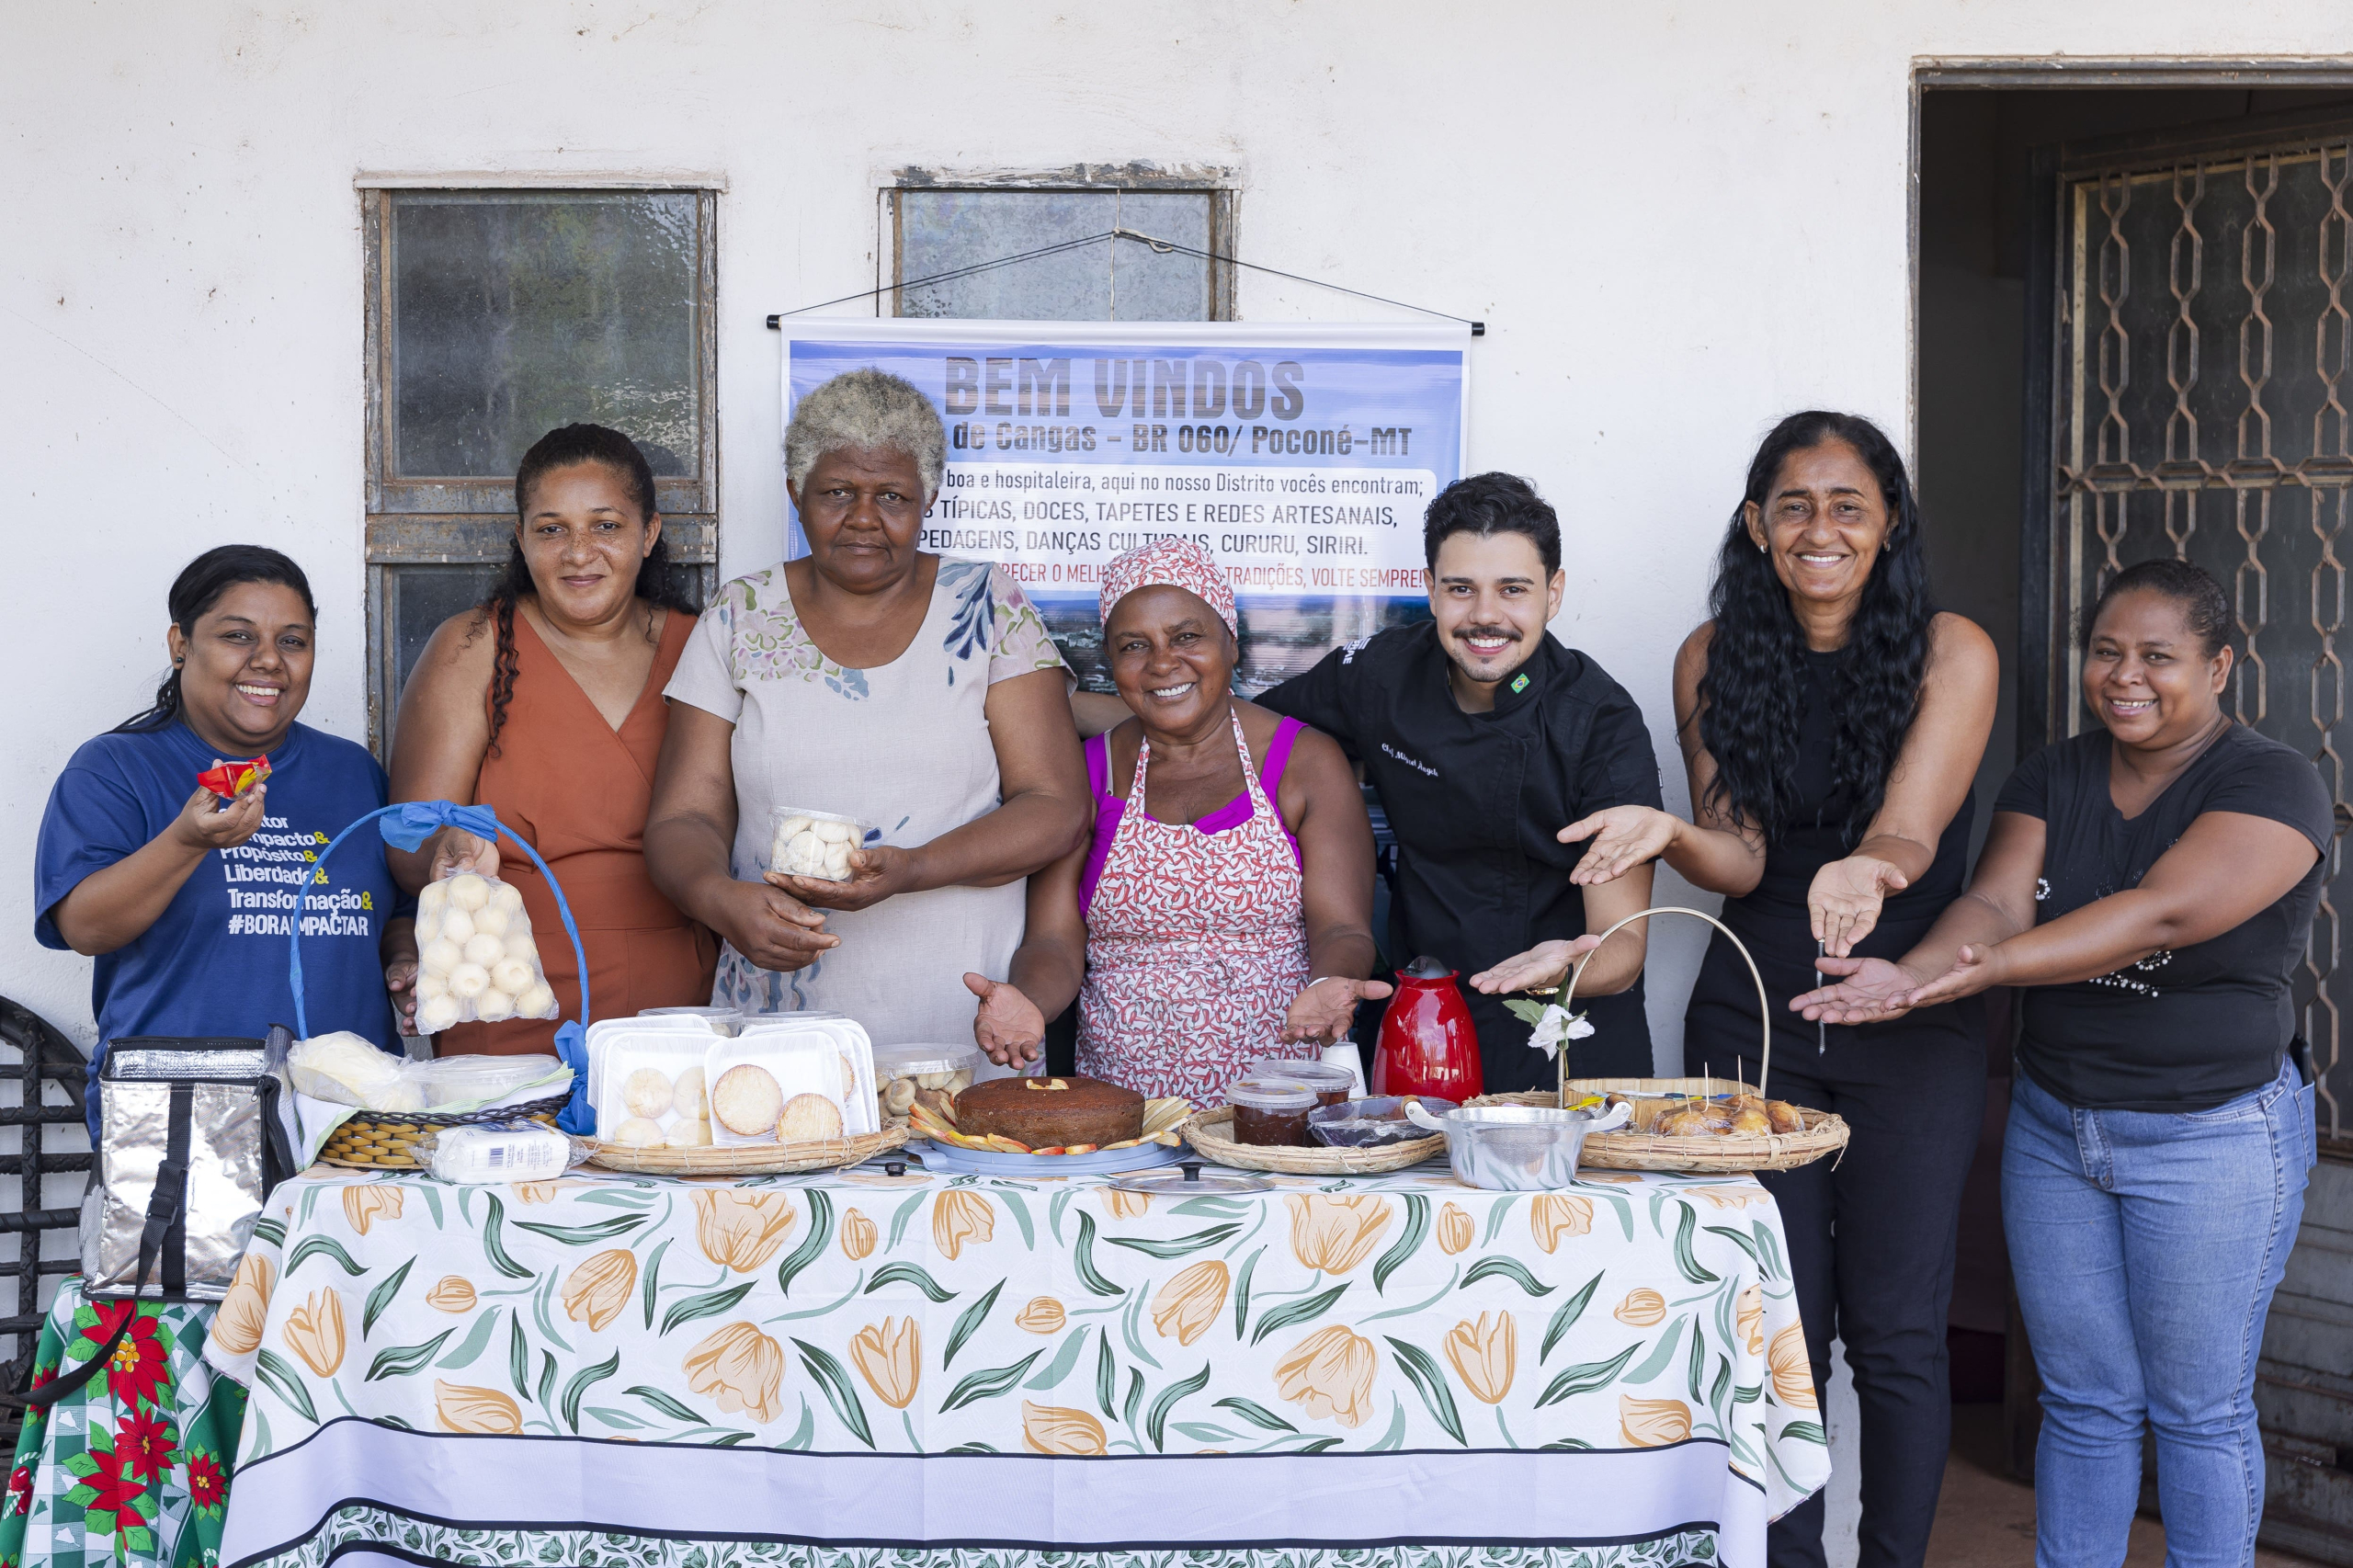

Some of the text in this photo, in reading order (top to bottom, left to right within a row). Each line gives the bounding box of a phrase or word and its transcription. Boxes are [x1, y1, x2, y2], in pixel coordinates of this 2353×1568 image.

[945, 357, 1305, 421] BEM VINDOS
[953, 421, 985, 449] de
[995, 421, 1097, 453] Cangas
[1132, 424, 1168, 452] BR
[1252, 425, 1413, 457] Poconé-MT
[947, 469, 1424, 497] boa e hospitaleira, aqui no nosso Distrito vocês encontram;
[940, 495, 1017, 522] TÍPICAS,
[1024, 502, 1089, 523] DOCES,
[1096, 503, 1178, 522] TAPETES
[1187, 504, 1197, 522] E
[1204, 505, 1265, 523] REDES
[1272, 506, 1398, 528] ARTESANAIS,
[917, 529, 1369, 556] PEDAGENS, DANÇAS CULTIS, CURURU, SIRIRI.
[1000, 562, 1424, 590] RECER O MELH TRADIÇÕES, VOLTE SEMPRE!
[248, 831, 331, 846] mpacto&
